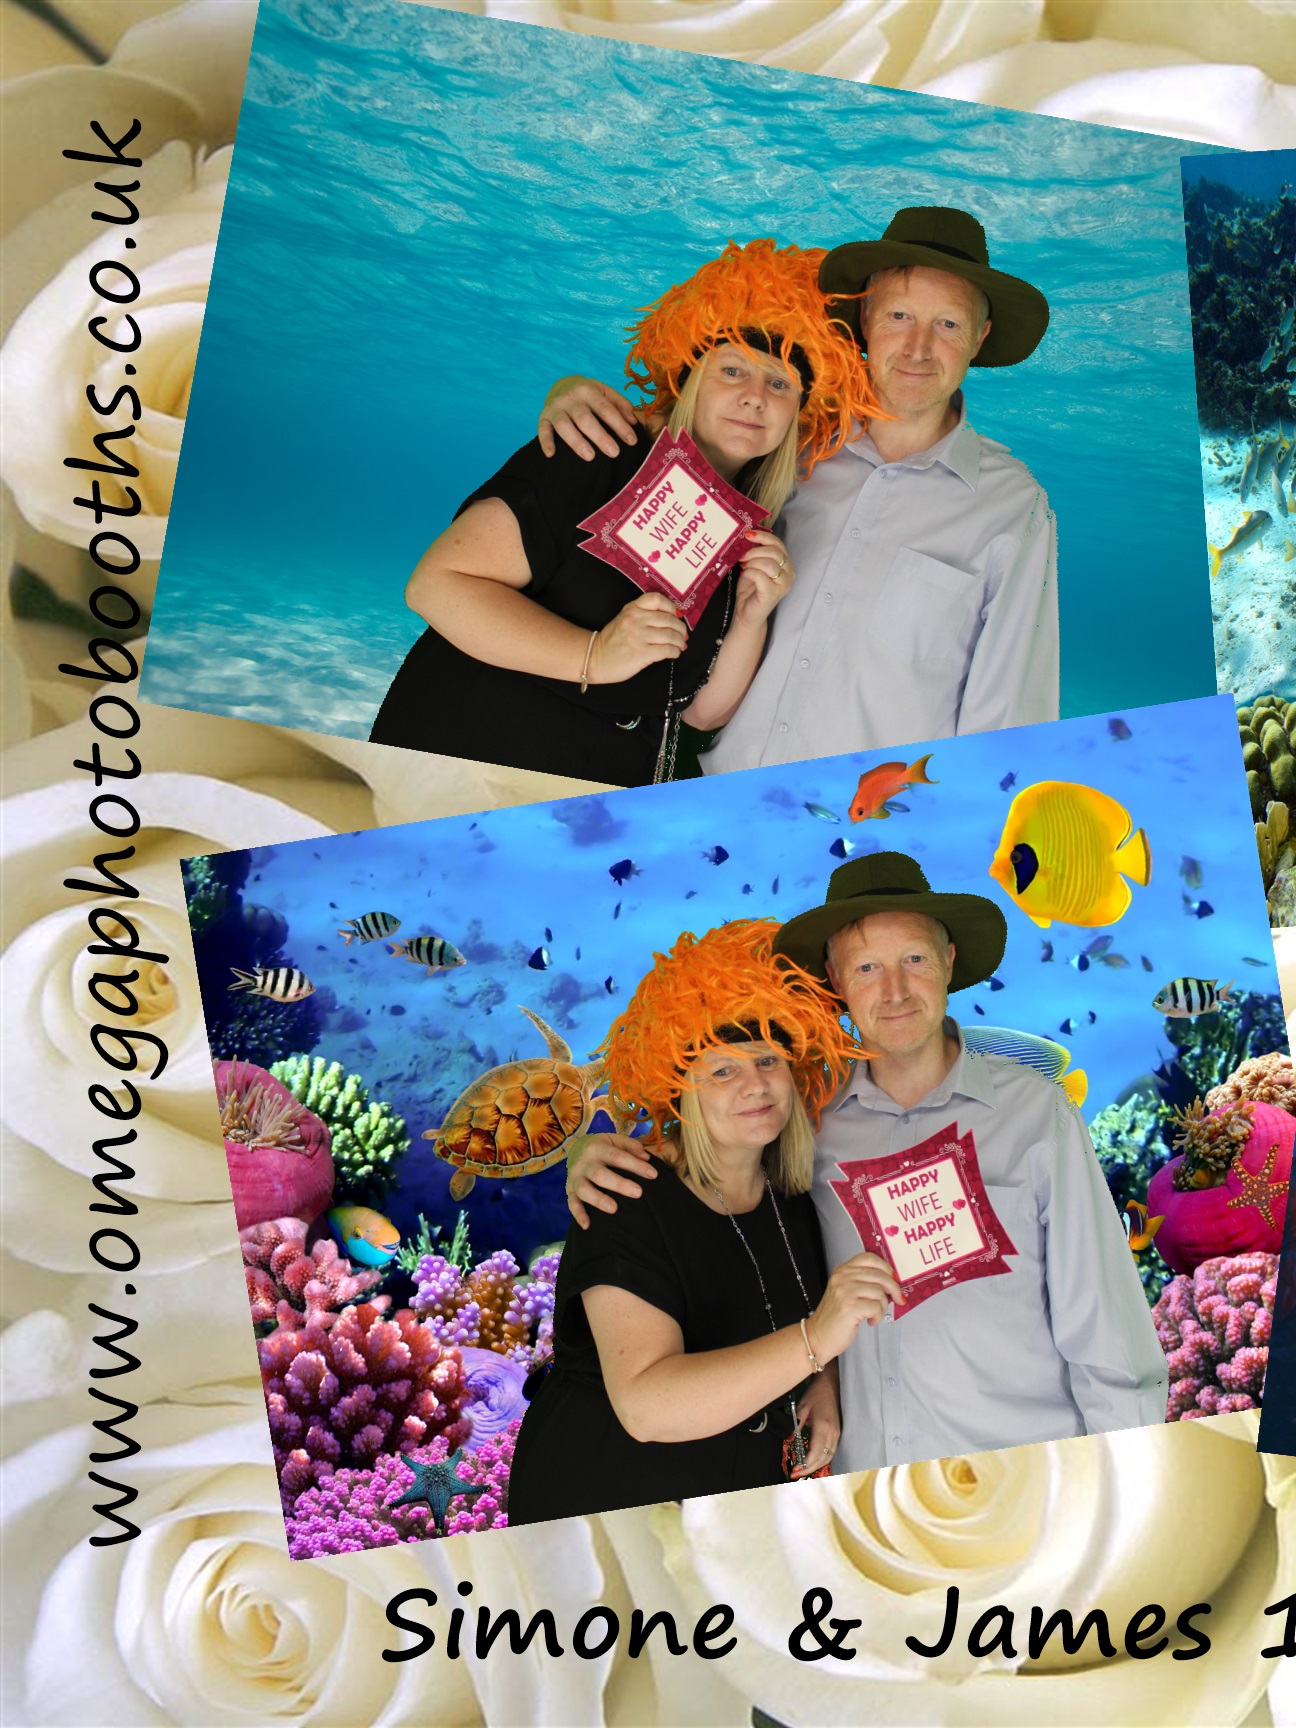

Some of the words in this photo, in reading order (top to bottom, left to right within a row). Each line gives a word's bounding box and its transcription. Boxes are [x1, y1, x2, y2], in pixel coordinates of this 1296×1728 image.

[632, 480, 675, 531] HAPPY
[648, 501, 689, 543] WIFE
[664, 510, 707, 560] HAPPY
[684, 532, 718, 569] LIFE
[886, 1168, 939, 1200] HAPPY
[896, 1191, 943, 1222] WIFE
[903, 1212, 955, 1244] HAPPY
[919, 1236, 956, 1266] LIFE
